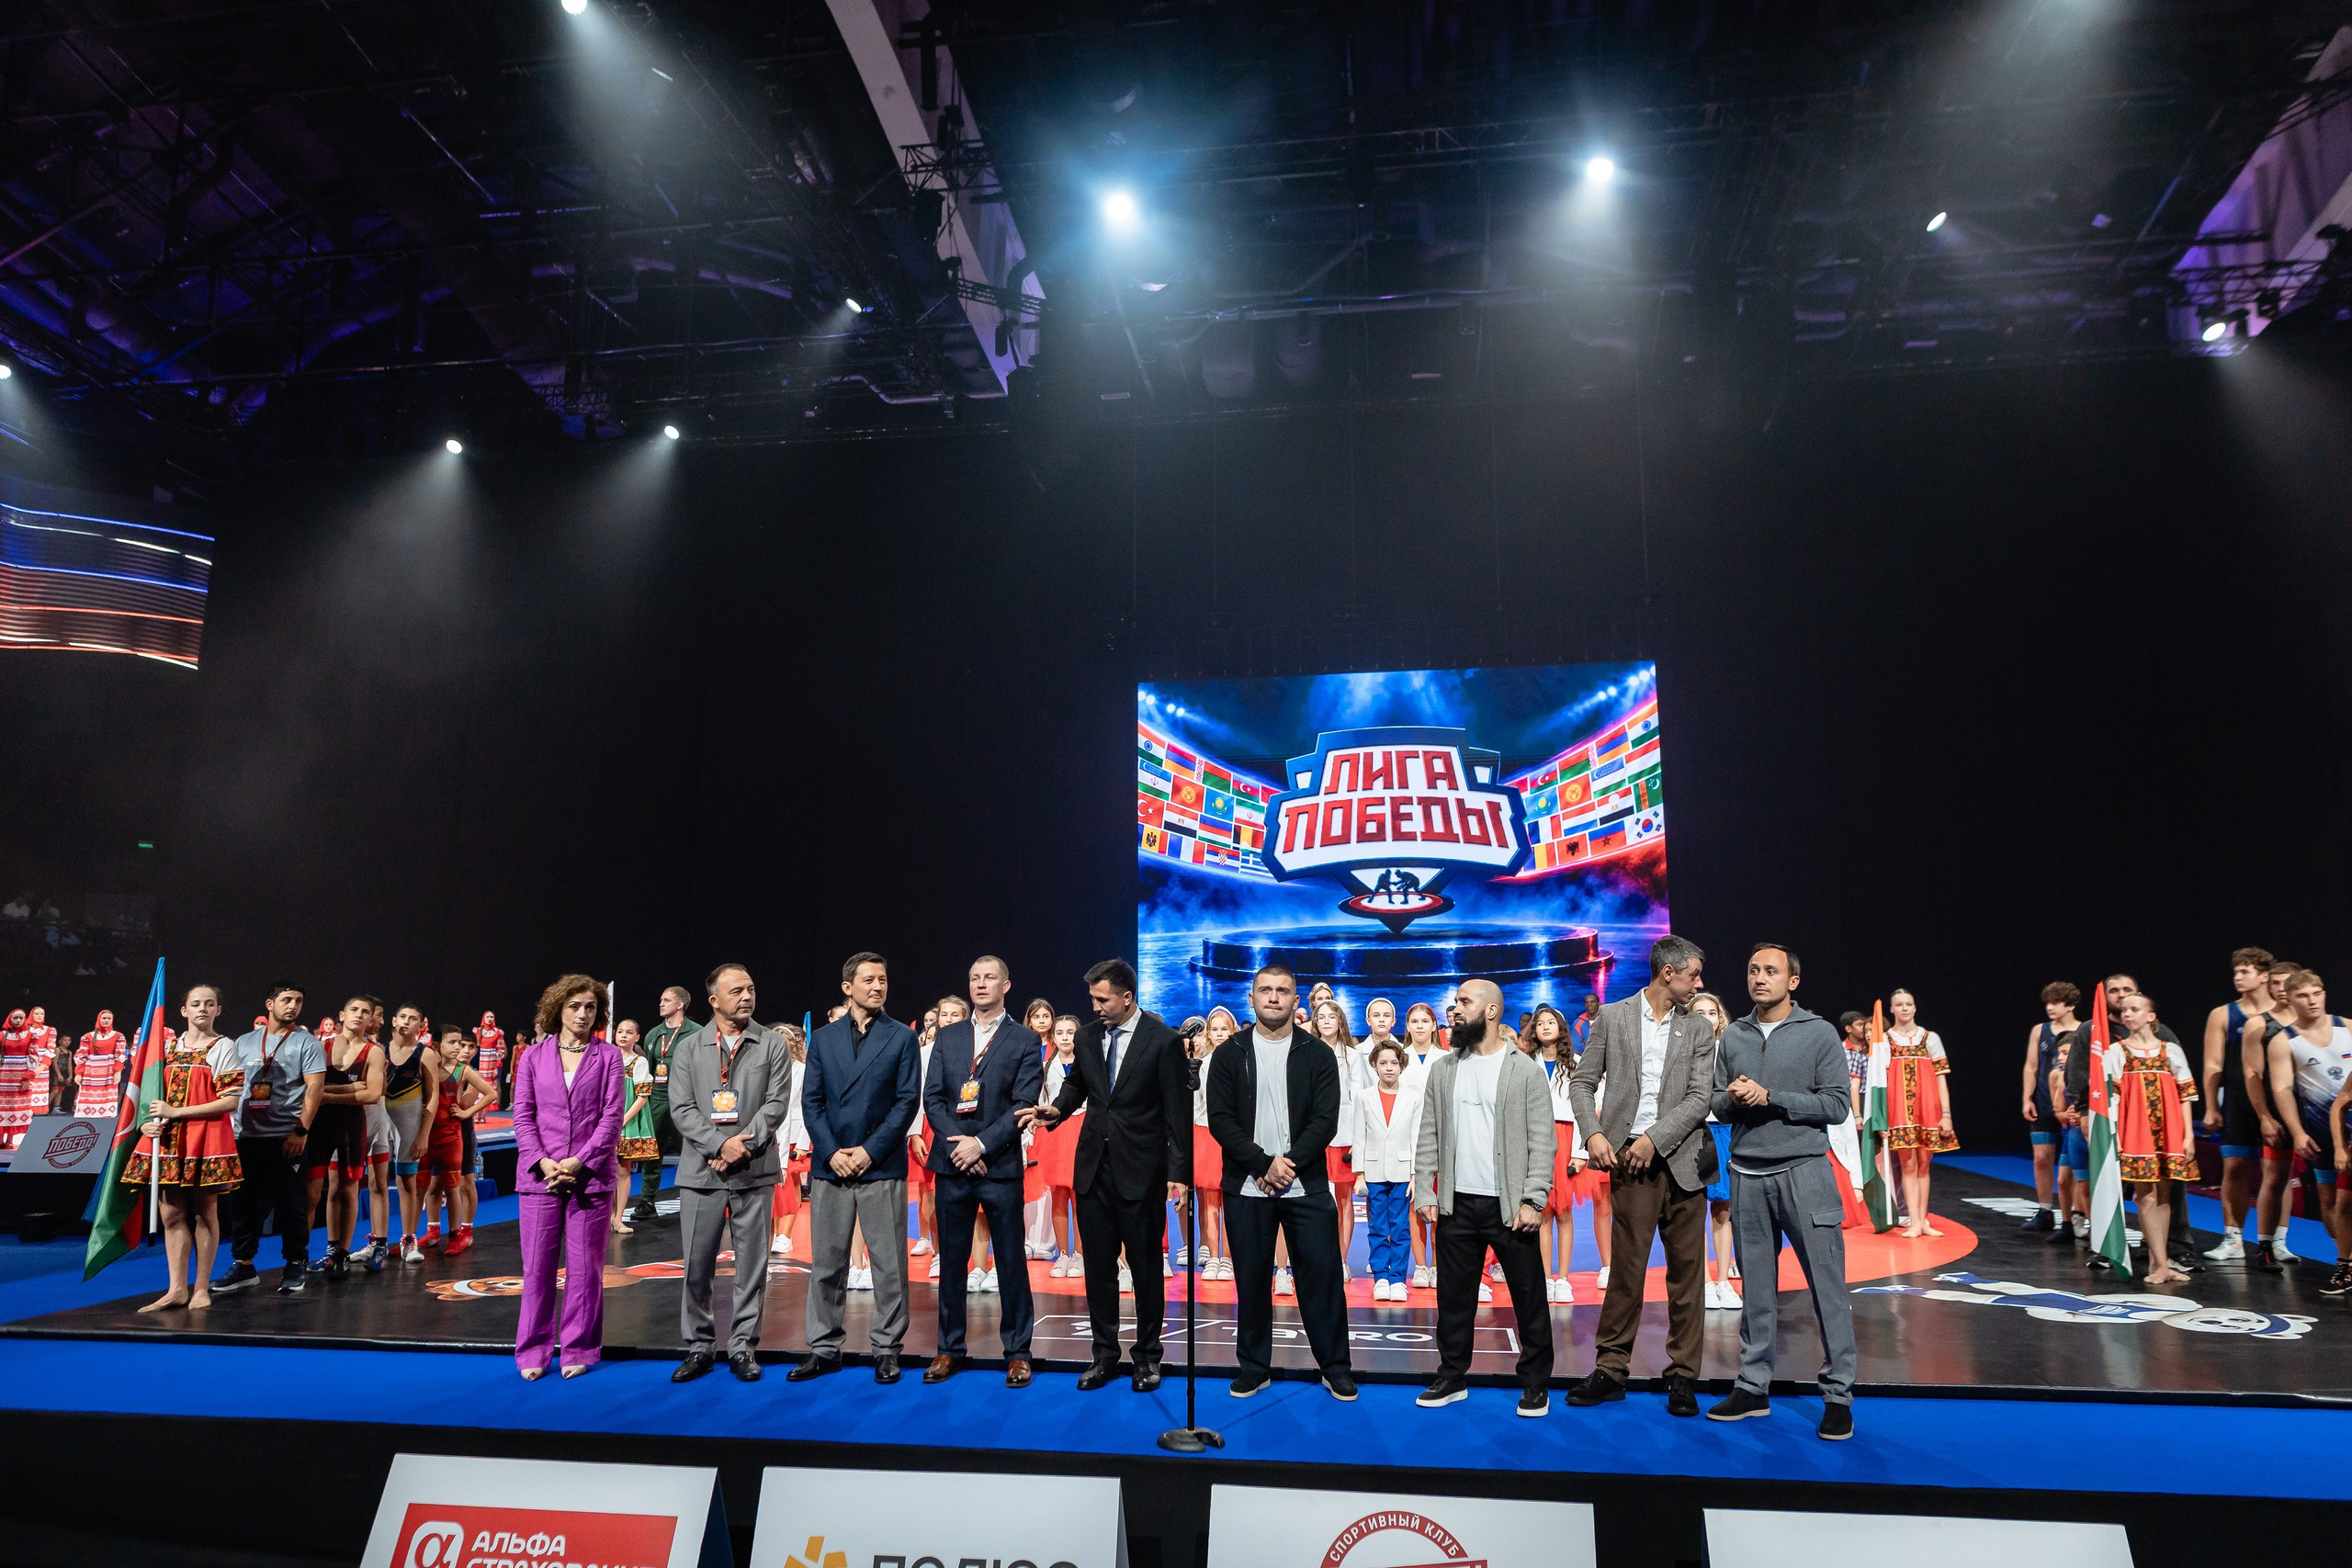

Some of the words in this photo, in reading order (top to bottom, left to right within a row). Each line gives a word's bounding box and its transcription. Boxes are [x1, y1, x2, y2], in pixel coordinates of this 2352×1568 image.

[1324, 750, 1459, 795] ЛИГА
[1283, 795, 1509, 853] ПОБЕДЫ
[48, 1134, 98, 1153] ПОБЕДА!
[470, 1530, 566, 1558] АЛЬФА
[1329, 1514, 1420, 1562] СПОРТИВНЫЙ
[1424, 1522, 1460, 1557] КЛУБ
